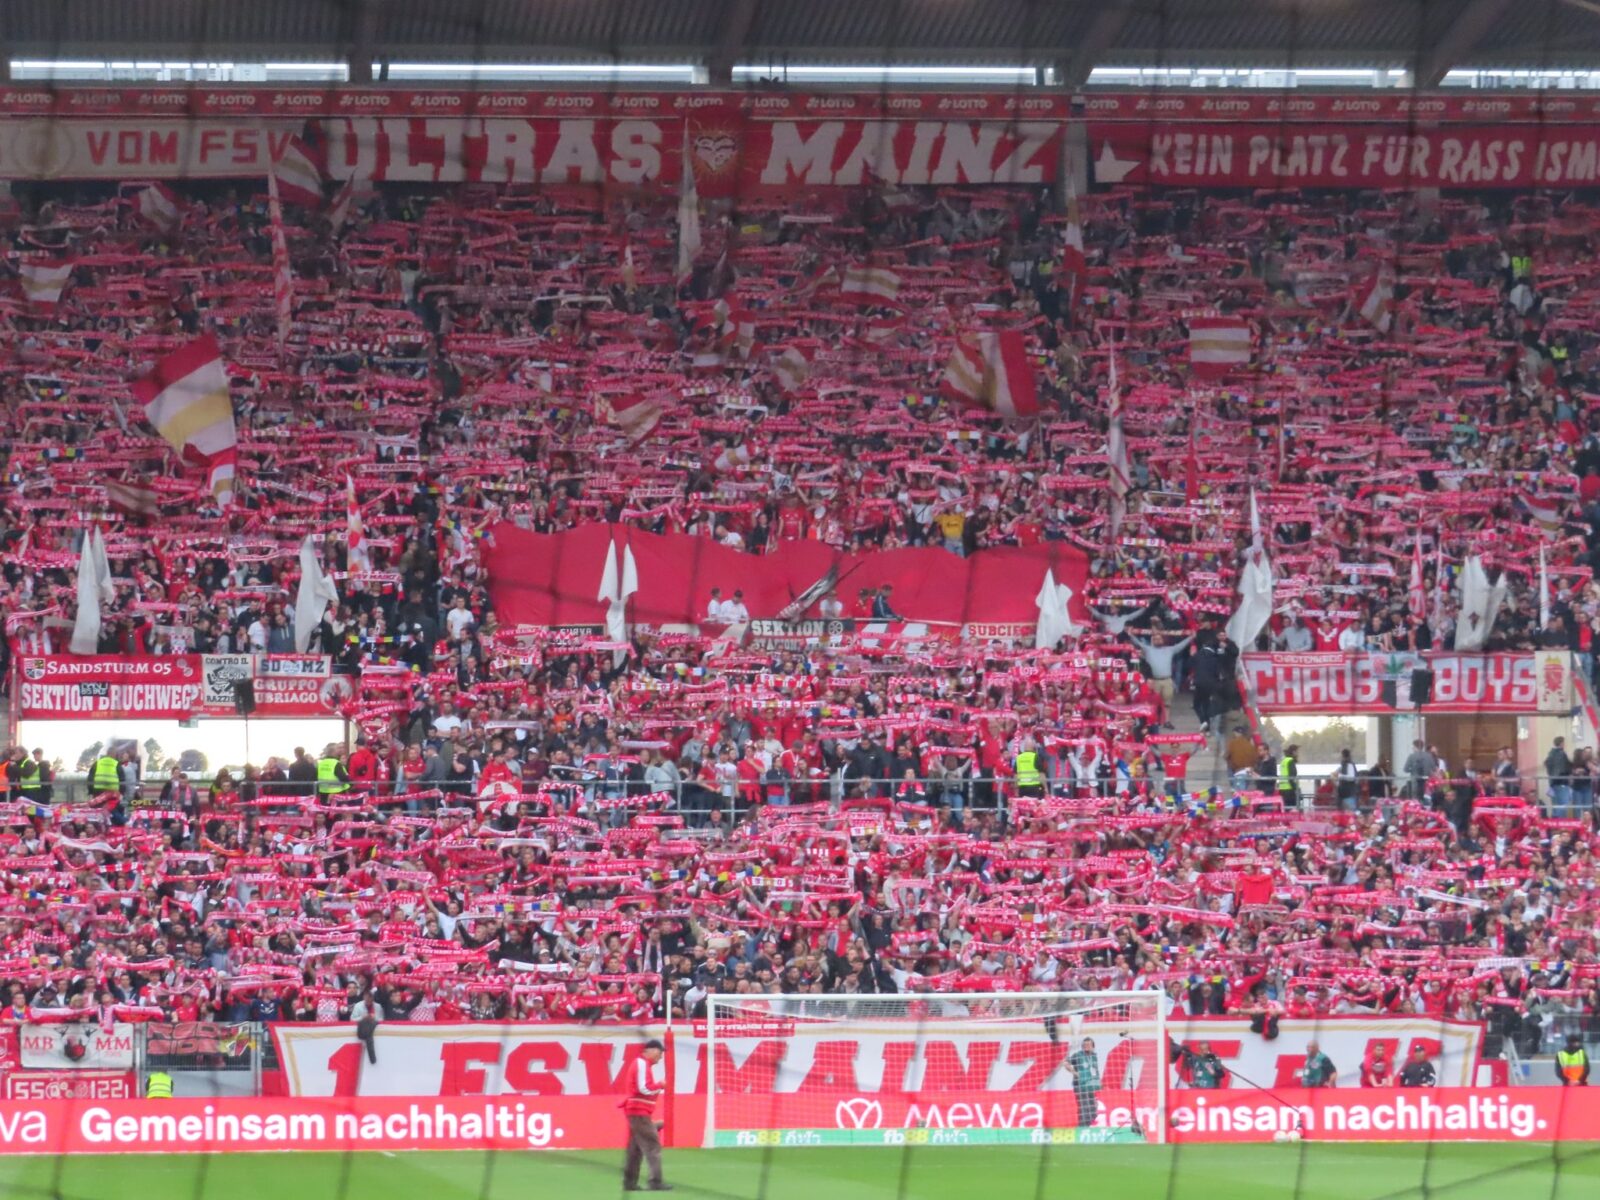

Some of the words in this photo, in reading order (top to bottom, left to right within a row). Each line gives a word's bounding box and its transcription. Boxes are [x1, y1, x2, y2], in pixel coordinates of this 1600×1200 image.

[17, 95, 53, 104] LOTTO
[84, 95, 120, 104] LOTTO
[151, 95, 187, 104] LOTTO
[218, 95, 255, 104] LOTTO
[286, 96, 322, 104] LOTTO
[354, 96, 390, 105] LOTTO
[425, 96, 460, 106] LOTTO
[492, 97, 527, 106] LOTTO
[558, 97, 594, 106] LOTTO
[624, 97, 659, 106] LOTTO
[754, 98, 790, 107] LOTTO
[820, 98, 855, 108] LOTTO
[886, 99, 922, 108] LOTTO
[952, 99, 988, 108] LOTTO
[1019, 100, 1053, 108] LOTTO
[1085, 100, 1119, 109] LOTTO
[1150, 100, 1184, 110] LOTTO
[1215, 100, 1250, 110] LOTTO
[1281, 101, 1315, 110] LOTTO
[1346, 101, 1380, 110] LOTTO
[1412, 102, 1446, 111] LOTTO
[1476, 102, 1511, 112] LOTTO
[1542, 102, 1576, 112] LOTTO
[86, 131, 178, 164] VOM
[200, 130, 291, 165] FSV
[319, 118, 663, 184] ULTRAS
[760, 121, 1060, 184] MAINZ
[1149, 133, 1233, 177] KEIN
[1248, 134, 1349, 177] PLATZ
[1361, 135, 1430, 178] FÜR
[750, 620, 825, 637] SEKTION
[205, 657, 239, 665] CONTRO
[241, 657, 249, 665] IL
[47, 660, 149, 675] SANDSTURM
[152, 663, 172, 676] 05
[260, 660, 281, 672] SD
[302, 660, 325, 673] MZ
[253, 679, 319, 691] GRUPPO
[1246, 657, 1380, 705] CHAOS
[1431, 657, 1537, 703] BOYS
[22, 683, 95, 711] SEKTION
[98, 684, 193, 711] BRUCHWEG
[254, 691, 319, 704] UBRIAGO
[23, 1036, 54, 1051] MB
[95, 1036, 132, 1050] MM
[439, 1042, 646, 1098] FSV
[695, 1040, 1070, 1094] MAINZ
[1324, 1095, 1547, 1137] nachhaltig.
[80, 1105, 326, 1142] Gemeinsam
[335, 1103, 565, 1147] nachhaltig.
[736, 1130, 782, 1145] fb88
[883, 1129, 929, 1144] fb88
[1030, 1128, 1076, 1144] fb88
